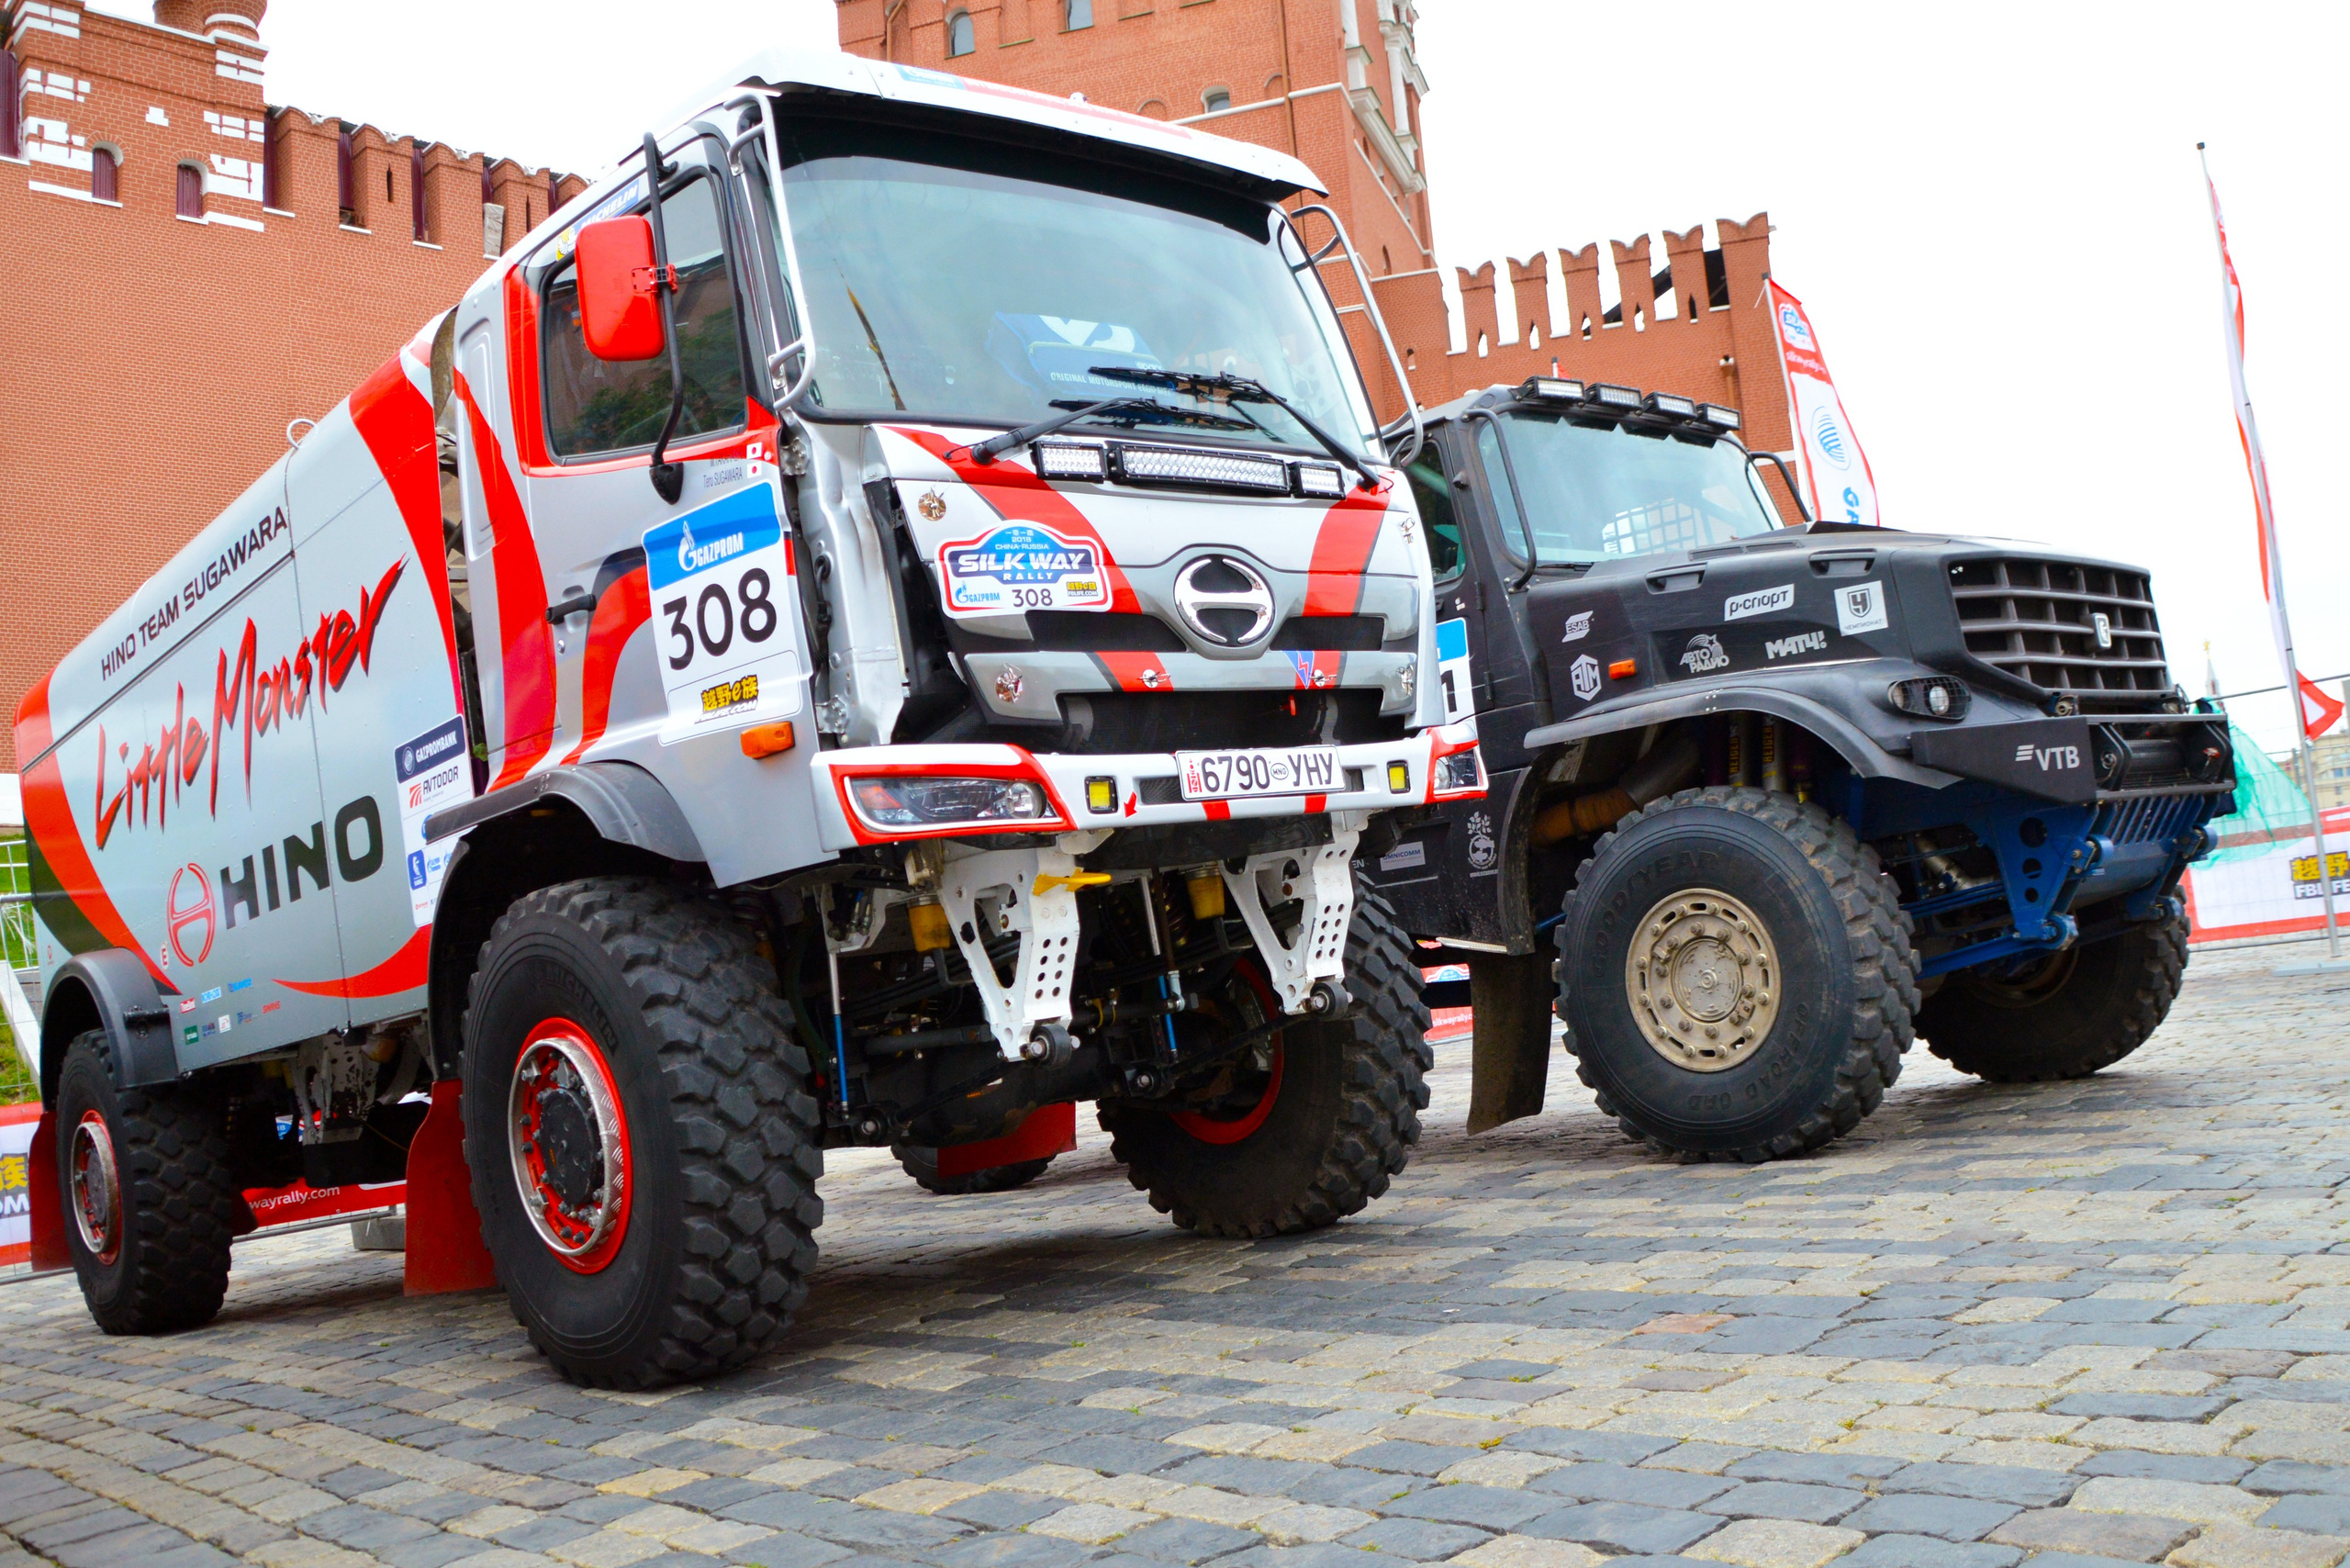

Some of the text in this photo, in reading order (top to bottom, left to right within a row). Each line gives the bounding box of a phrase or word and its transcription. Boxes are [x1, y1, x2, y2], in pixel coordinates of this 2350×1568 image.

[1050, 372, 1087, 384] ORIGINAL
[697, 532, 744, 567] GAZPROM
[957, 553, 1085, 573] SILK WAY
[1002, 572, 1053, 581] RALLY
[101, 506, 287, 680] HINO TEAM SUGAWARA
[968, 593, 1001, 602] GAZPROM
[1012, 588, 1053, 608] 308
[663, 567, 778, 670] 308
[1566, 621, 1589, 633] ESAB
[1679, 648, 1710, 666] АВТО
[1689, 655, 1729, 673] РАДИО
[210, 553, 409, 821] Monster
[416, 731, 457, 763] GAZPROMBANK
[2035, 745, 2080, 771] VTB
[423, 766, 458, 795] AVTODOR
[1201, 755, 1270, 792] 6790
[220, 796, 384, 929] HINO
[2295, 879, 2350, 898] FBLFE
[1593, 850, 1719, 979] GOODYEAR
[249, 1186, 341, 1210] wayrally.com
